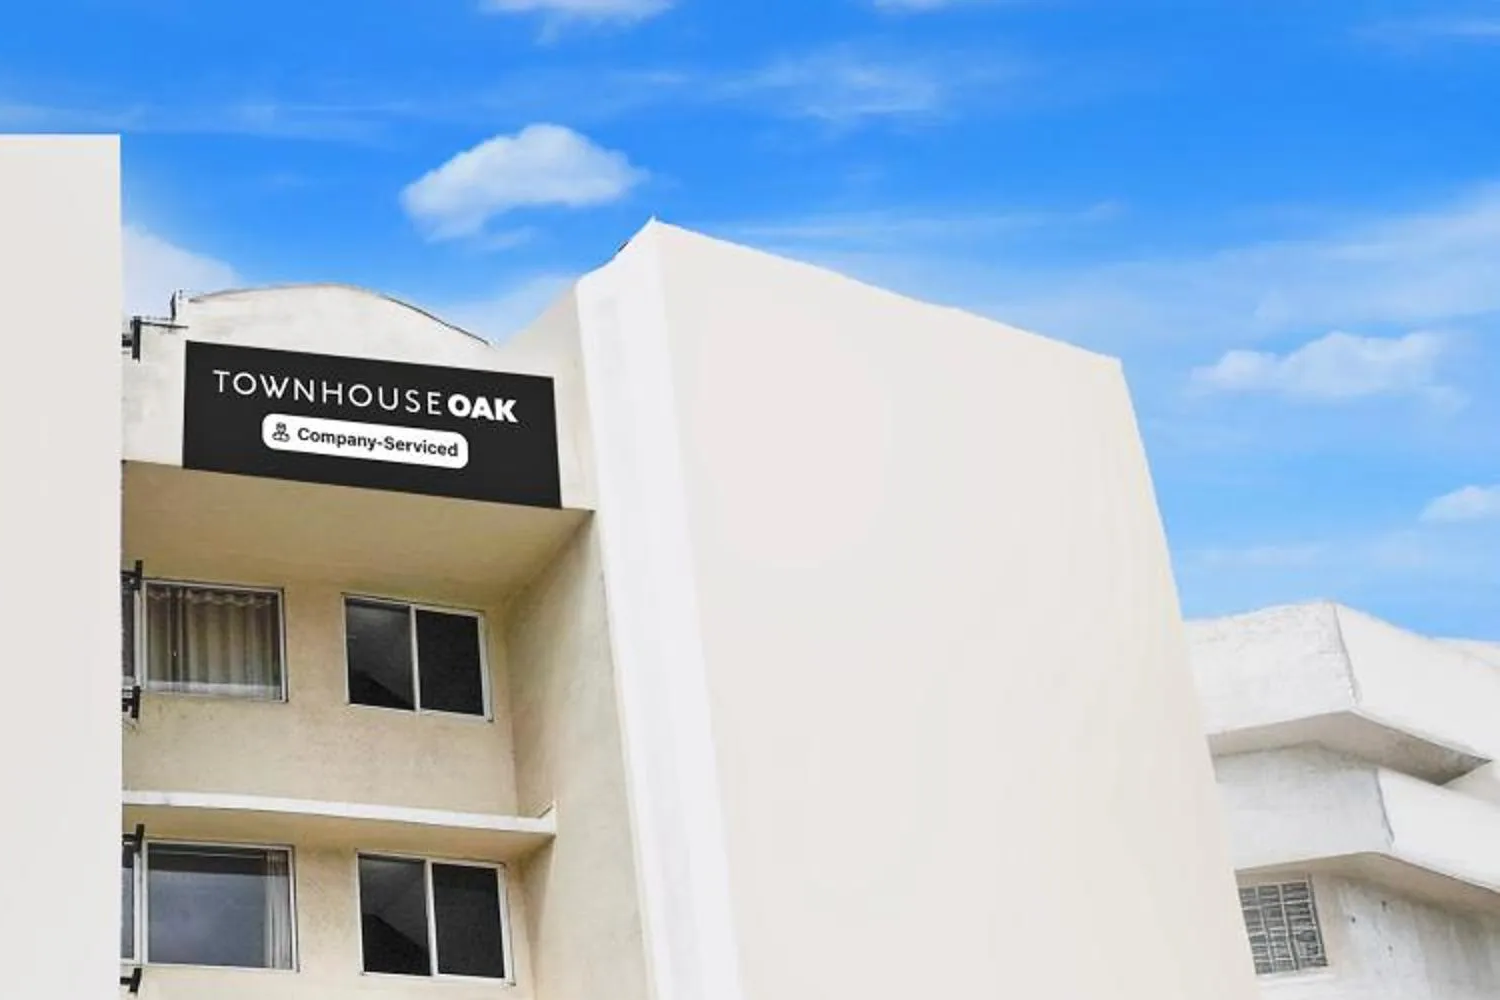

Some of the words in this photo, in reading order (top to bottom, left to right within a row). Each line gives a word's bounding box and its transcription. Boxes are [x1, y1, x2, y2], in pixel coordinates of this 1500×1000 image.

[213, 370, 442, 415] TOWNHOUSE
[448, 394, 518, 422] OAK
[297, 427, 459, 457] Company-Serviced
